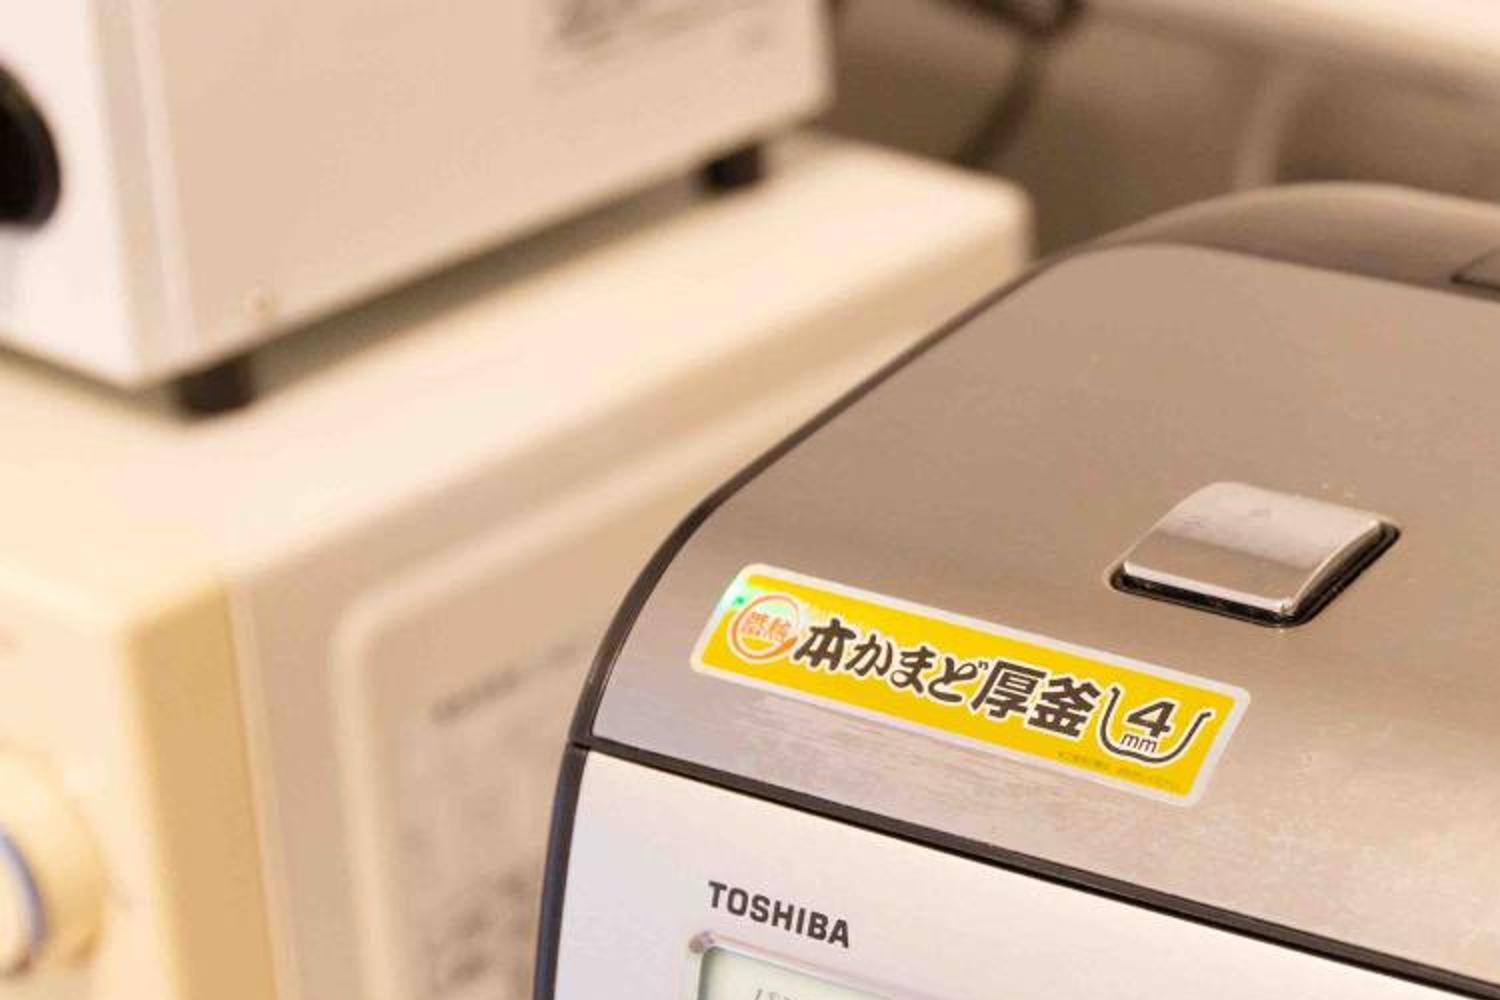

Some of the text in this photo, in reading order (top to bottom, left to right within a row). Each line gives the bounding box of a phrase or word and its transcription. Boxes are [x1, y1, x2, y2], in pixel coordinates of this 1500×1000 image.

[793, 618, 1100, 738] 本かまど厚釜
[1121, 733, 1158, 753] mm
[1127, 701, 1176, 738] 4
[708, 880, 850, 949] TOSHIBA
